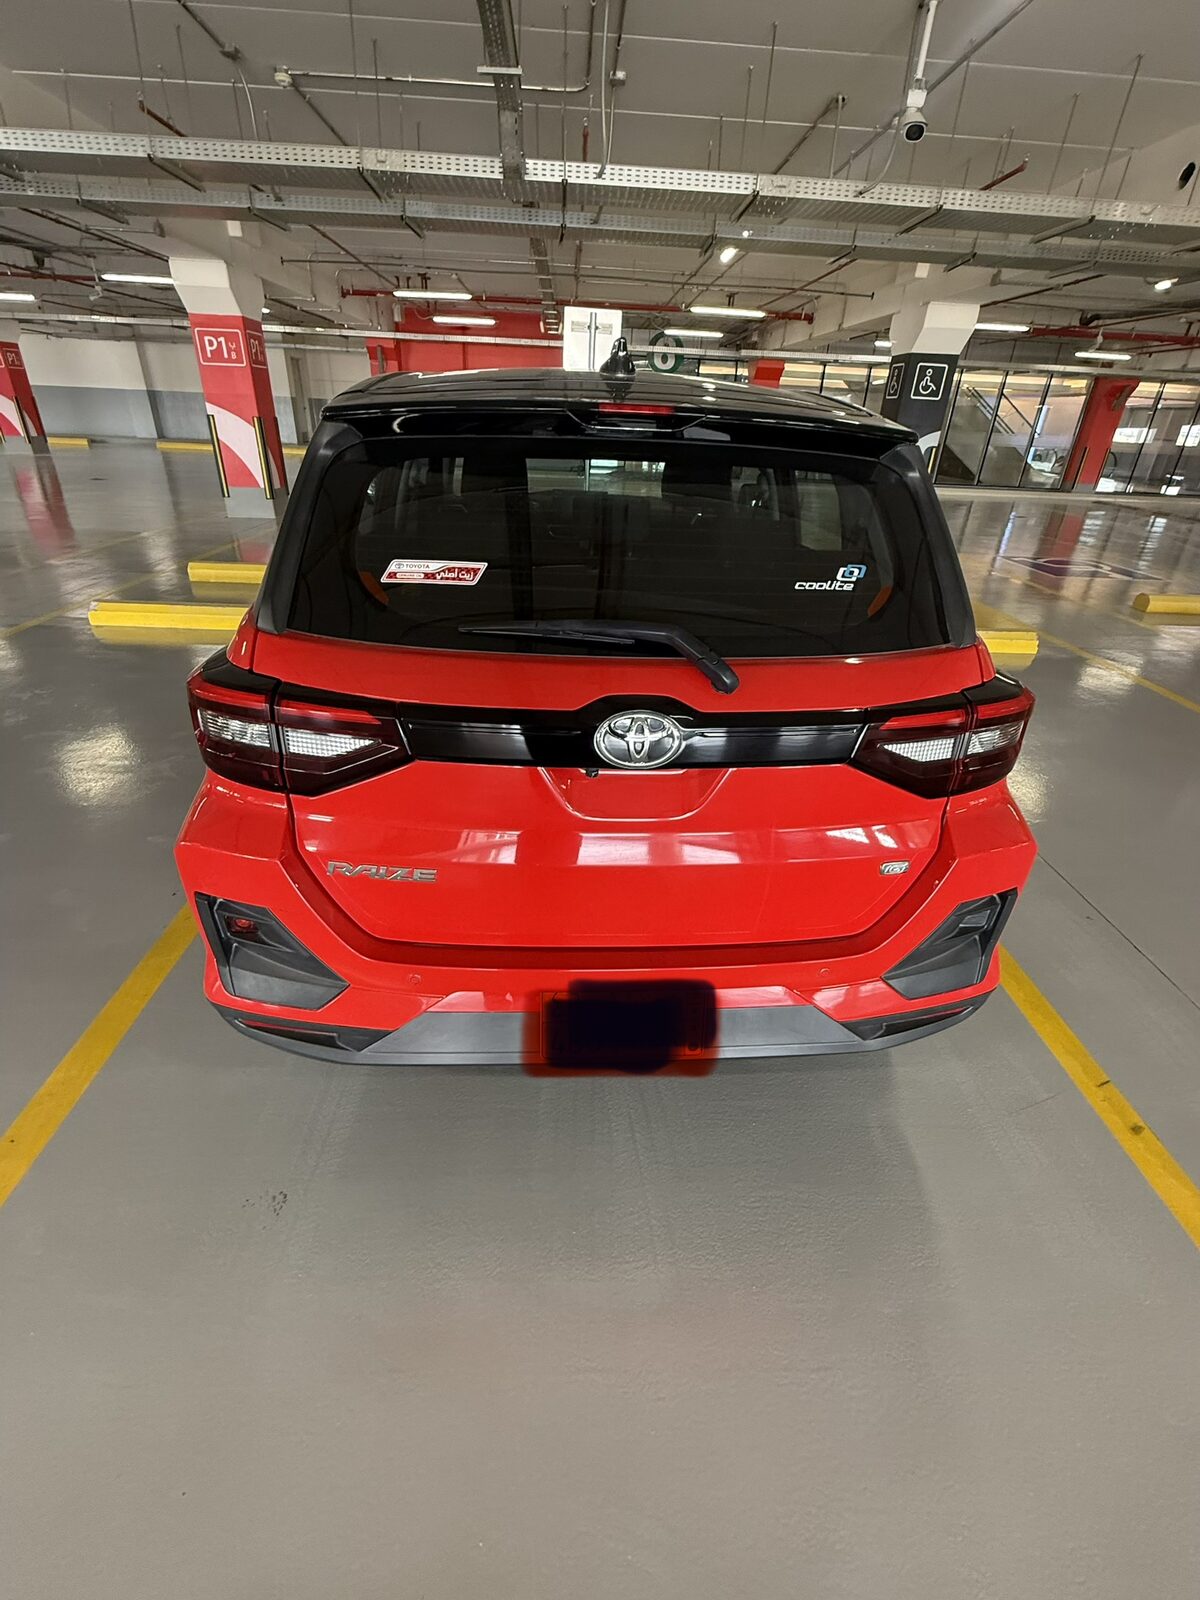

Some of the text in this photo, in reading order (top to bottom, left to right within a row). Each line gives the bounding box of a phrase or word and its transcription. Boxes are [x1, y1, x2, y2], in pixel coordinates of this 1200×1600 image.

[204, 335, 228, 358] P1
[250, 339, 261, 360] P1
[458, 570, 474, 581] زيت
[794, 580, 854, 591] coolite
[326, 861, 437, 882] RAIZE
